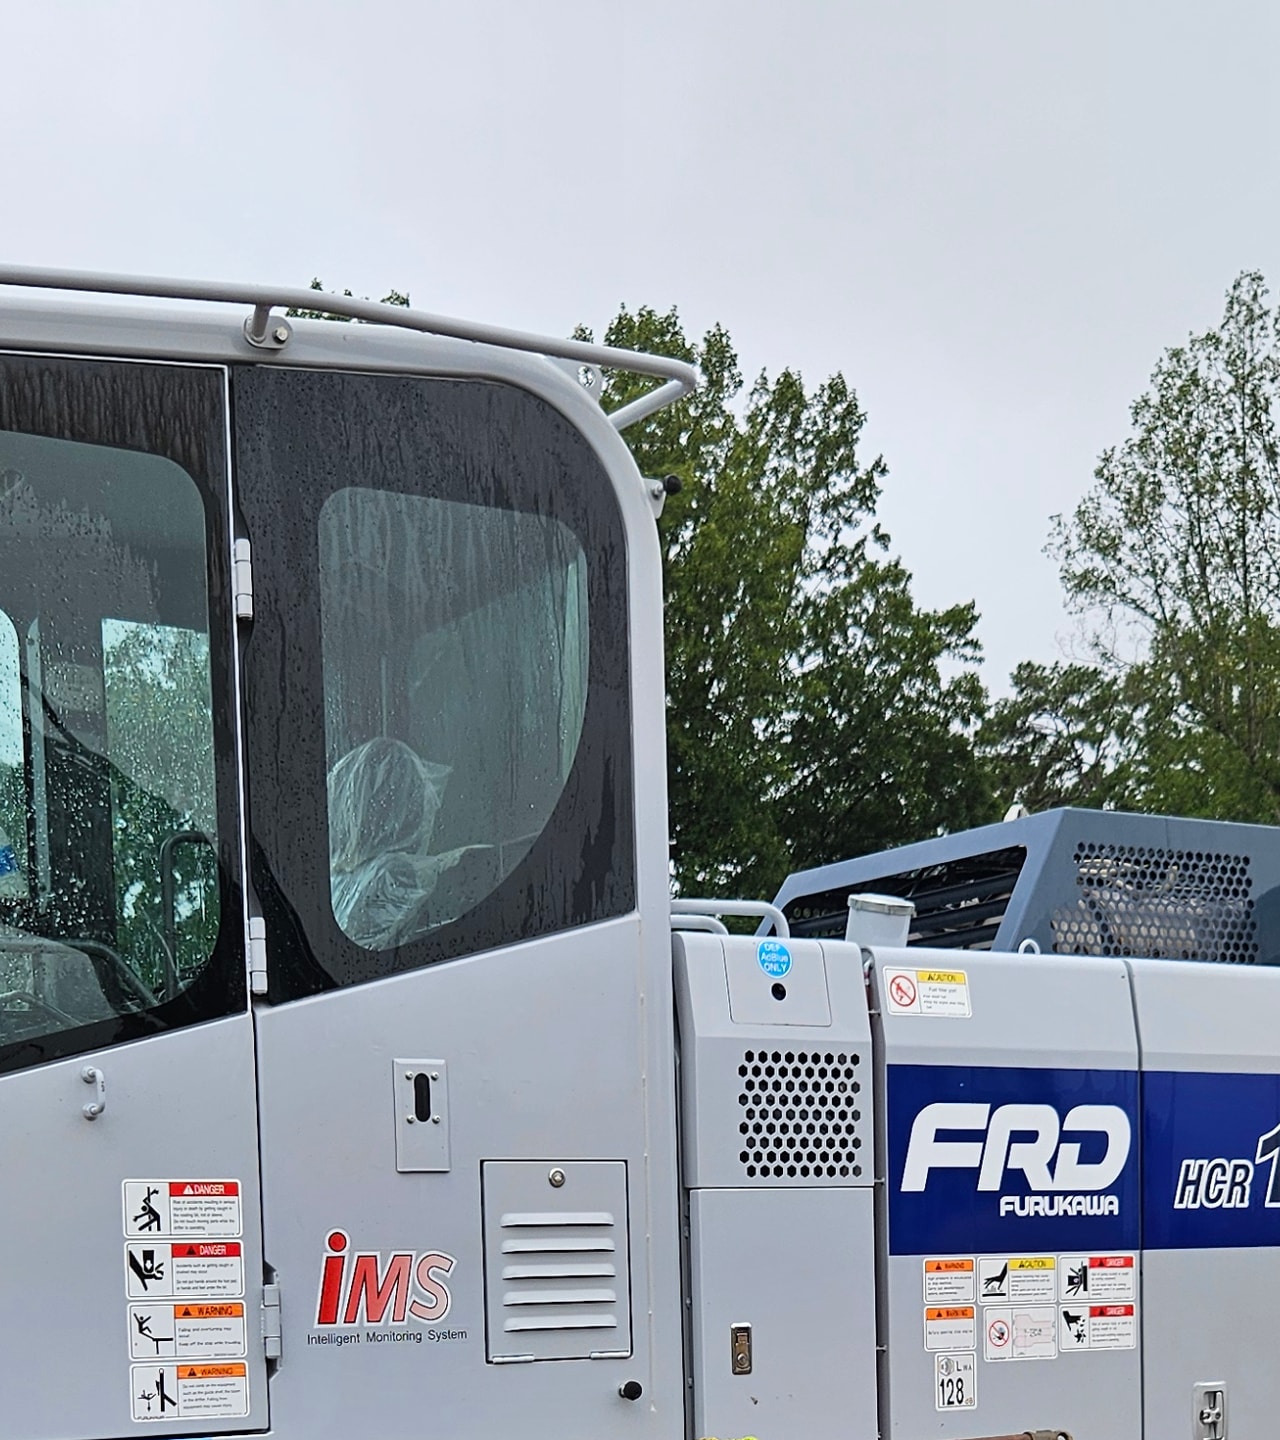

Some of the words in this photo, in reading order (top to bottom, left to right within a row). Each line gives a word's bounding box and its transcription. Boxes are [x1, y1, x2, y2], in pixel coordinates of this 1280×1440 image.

[764, 962, 786, 972] ONLY
[900, 1102, 1131, 1191] FRD
[193, 1184, 225, 1195] DANGER
[1173, 1158, 1255, 1208] HCR
[999, 1195, 1119, 1217] FURUKAWA
[199, 1245, 227, 1256] DANGER
[197, 1306, 233, 1316] WARNING
[307, 1334, 360, 1346] Intelligent
[366, 1331, 422, 1343] Monitoring
[427, 1329, 468, 1343] System
[201, 1367, 233, 1376] WARNING
[940, 1377, 964, 1405] 128
